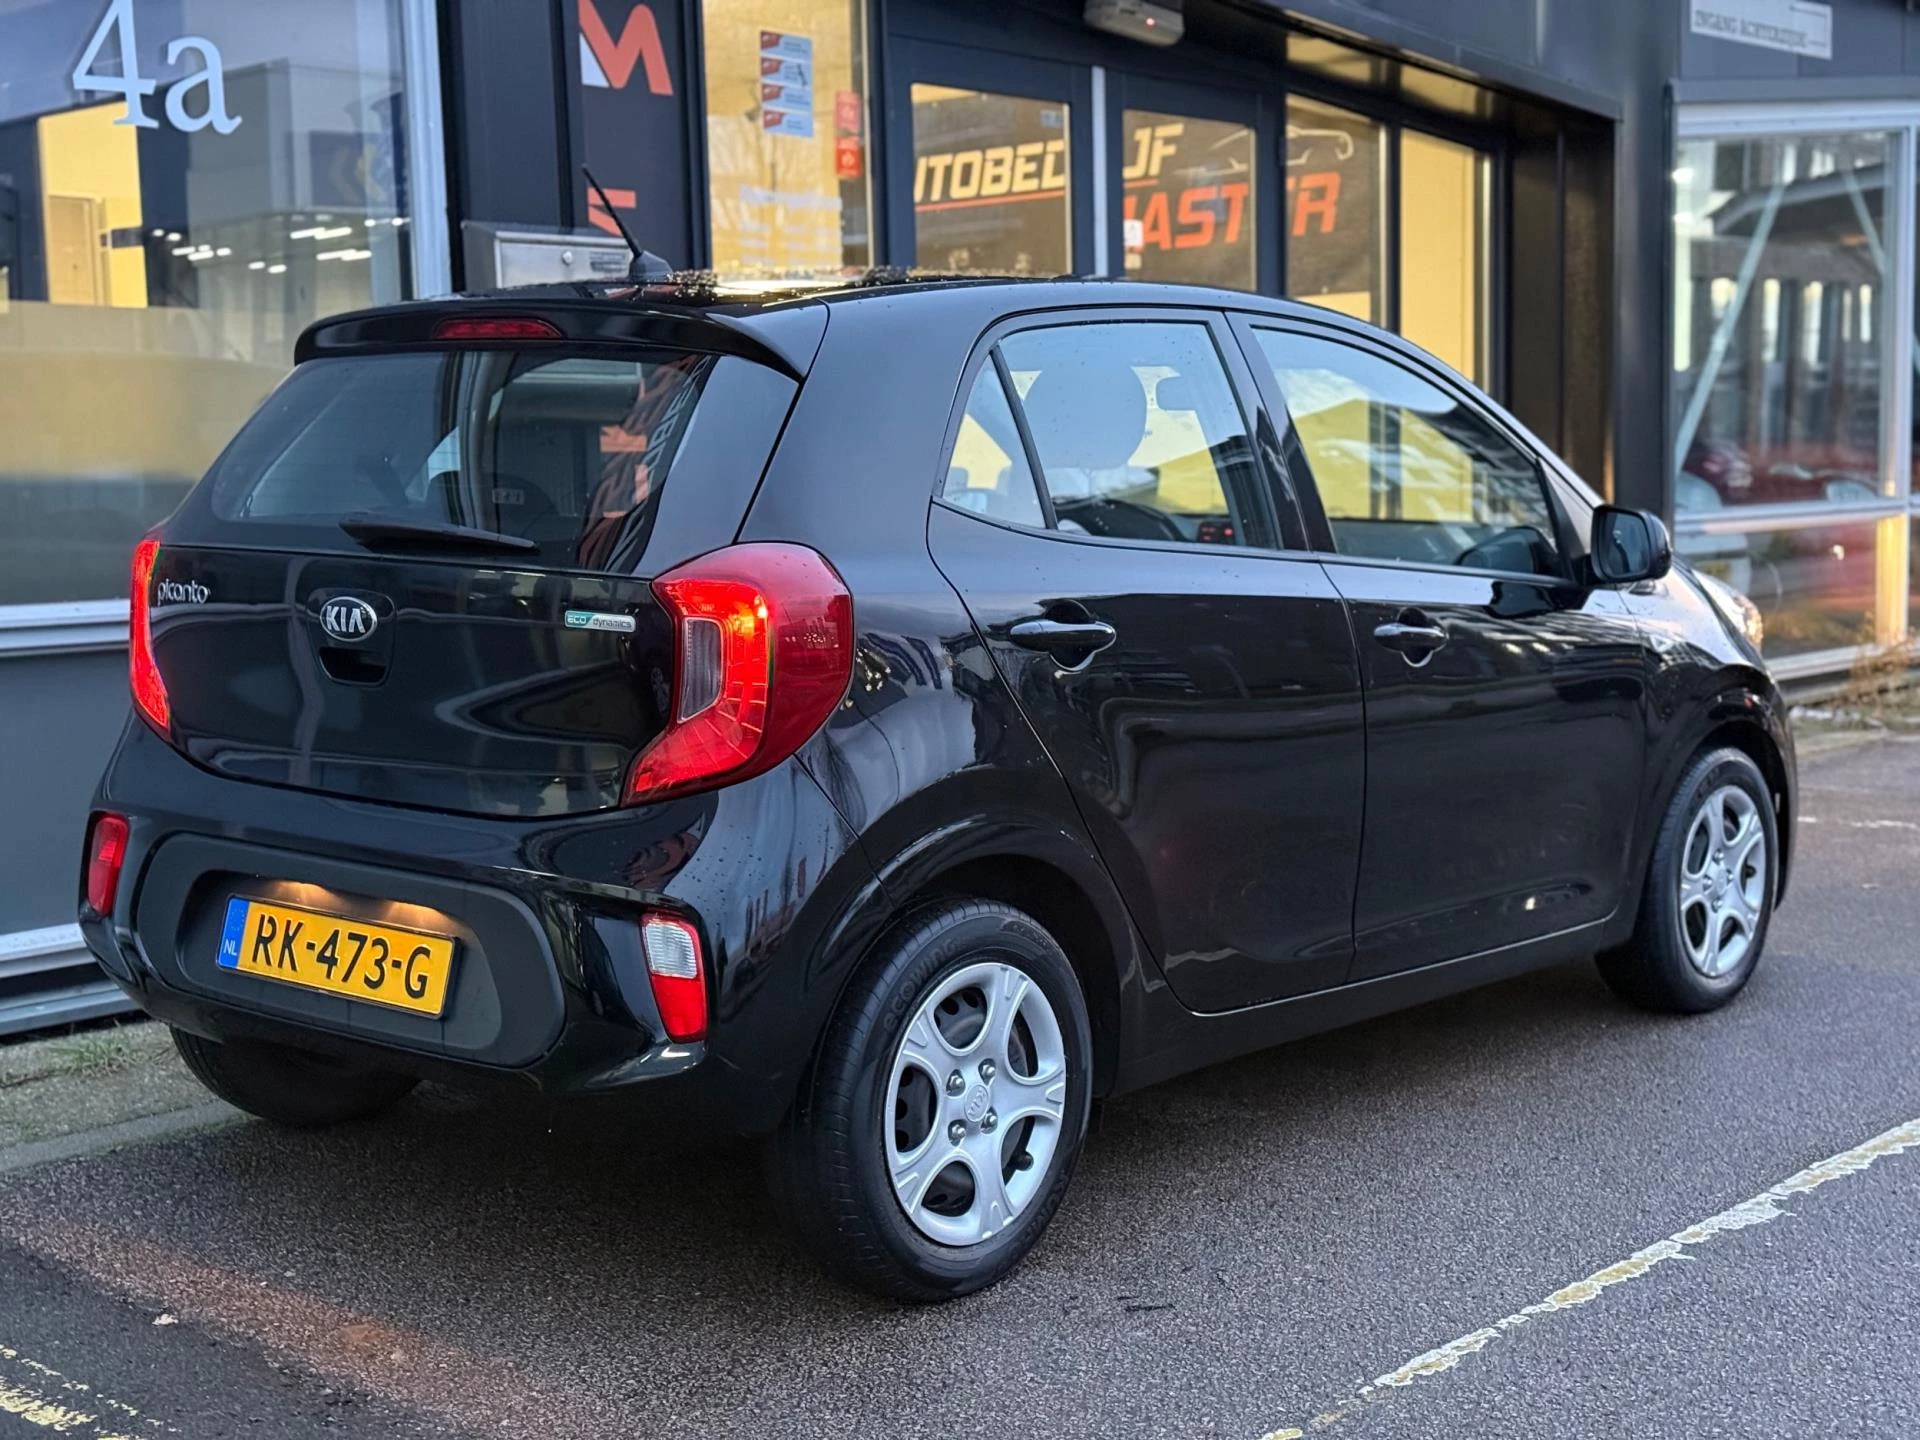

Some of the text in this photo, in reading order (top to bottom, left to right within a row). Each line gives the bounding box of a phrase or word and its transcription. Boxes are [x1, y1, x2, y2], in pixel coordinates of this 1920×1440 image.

[72, 0, 243, 134] 4a
[157, 578, 208, 607] picanto
[326, 605, 366, 633] KIA
[567, 614, 632, 629] ECO dynamics
[223, 939, 238, 957] NL
[251, 912, 432, 1000] RK-473-G
